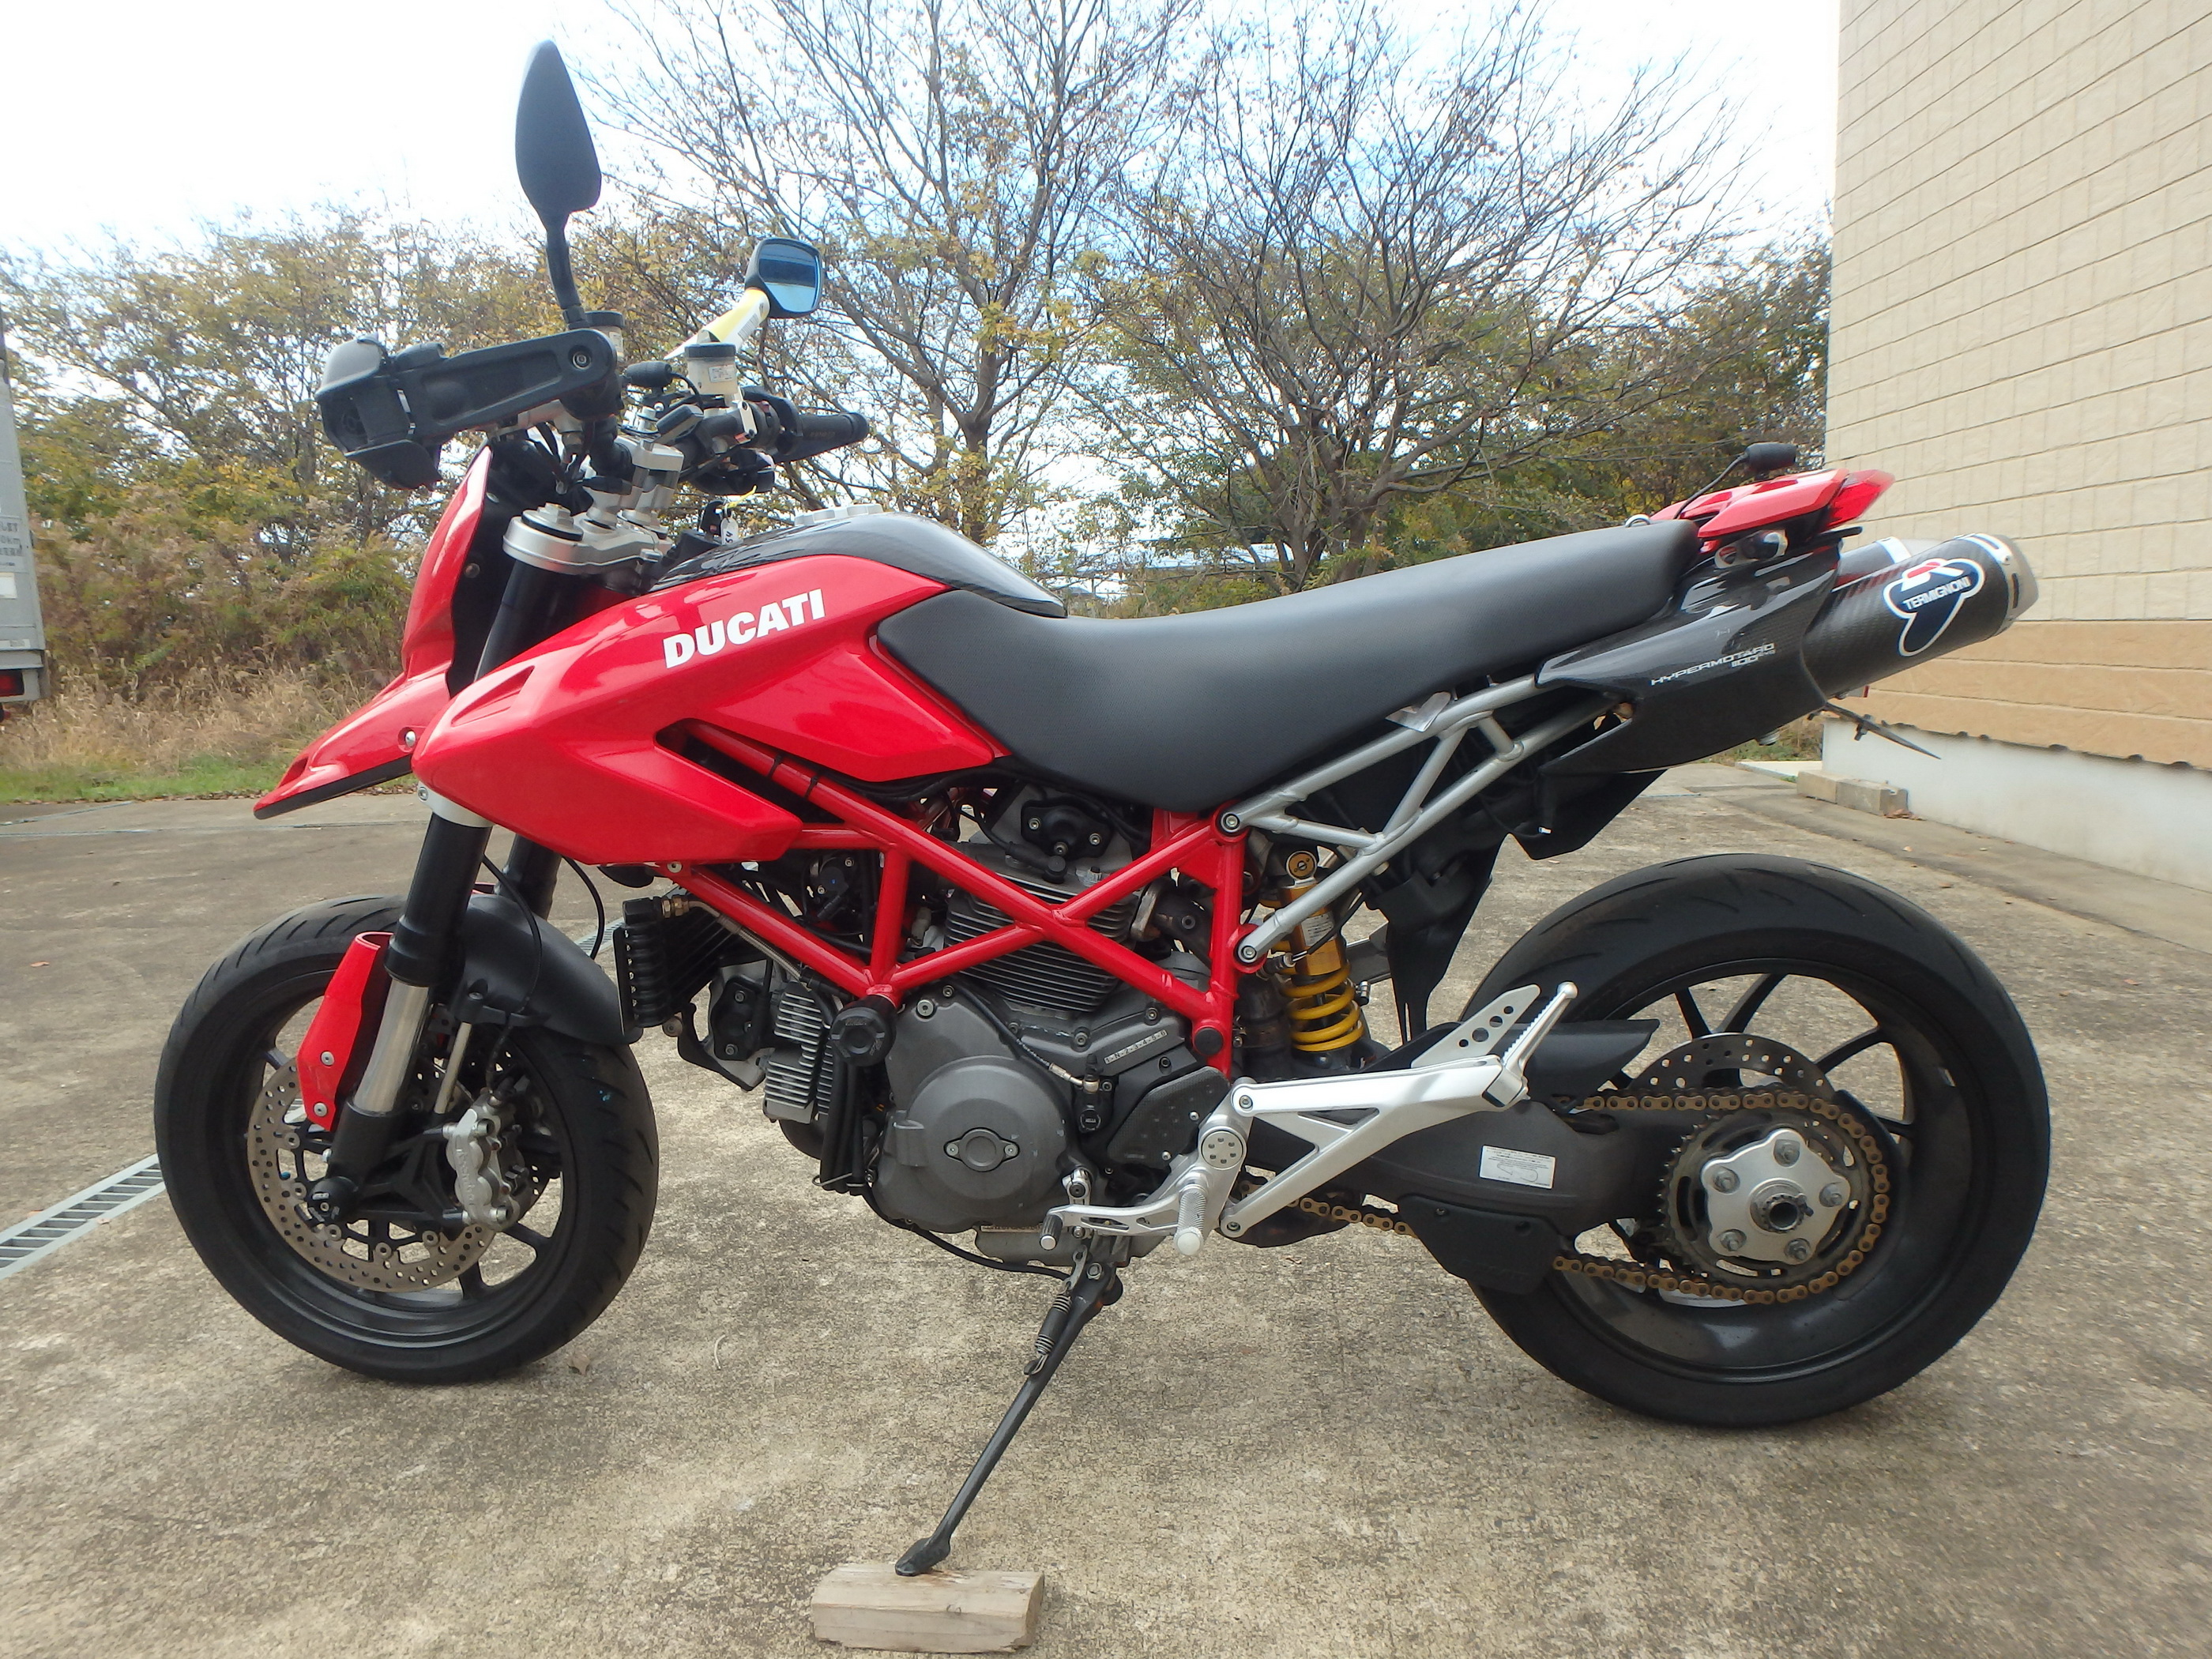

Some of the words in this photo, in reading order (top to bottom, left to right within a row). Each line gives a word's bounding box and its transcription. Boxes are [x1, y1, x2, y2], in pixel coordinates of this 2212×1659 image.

[1902, 576, 1972, 610] TERMIGNONI
[662, 588, 826, 669] DUCATI
[1651, 642, 1776, 686] HYPERMOTARD
